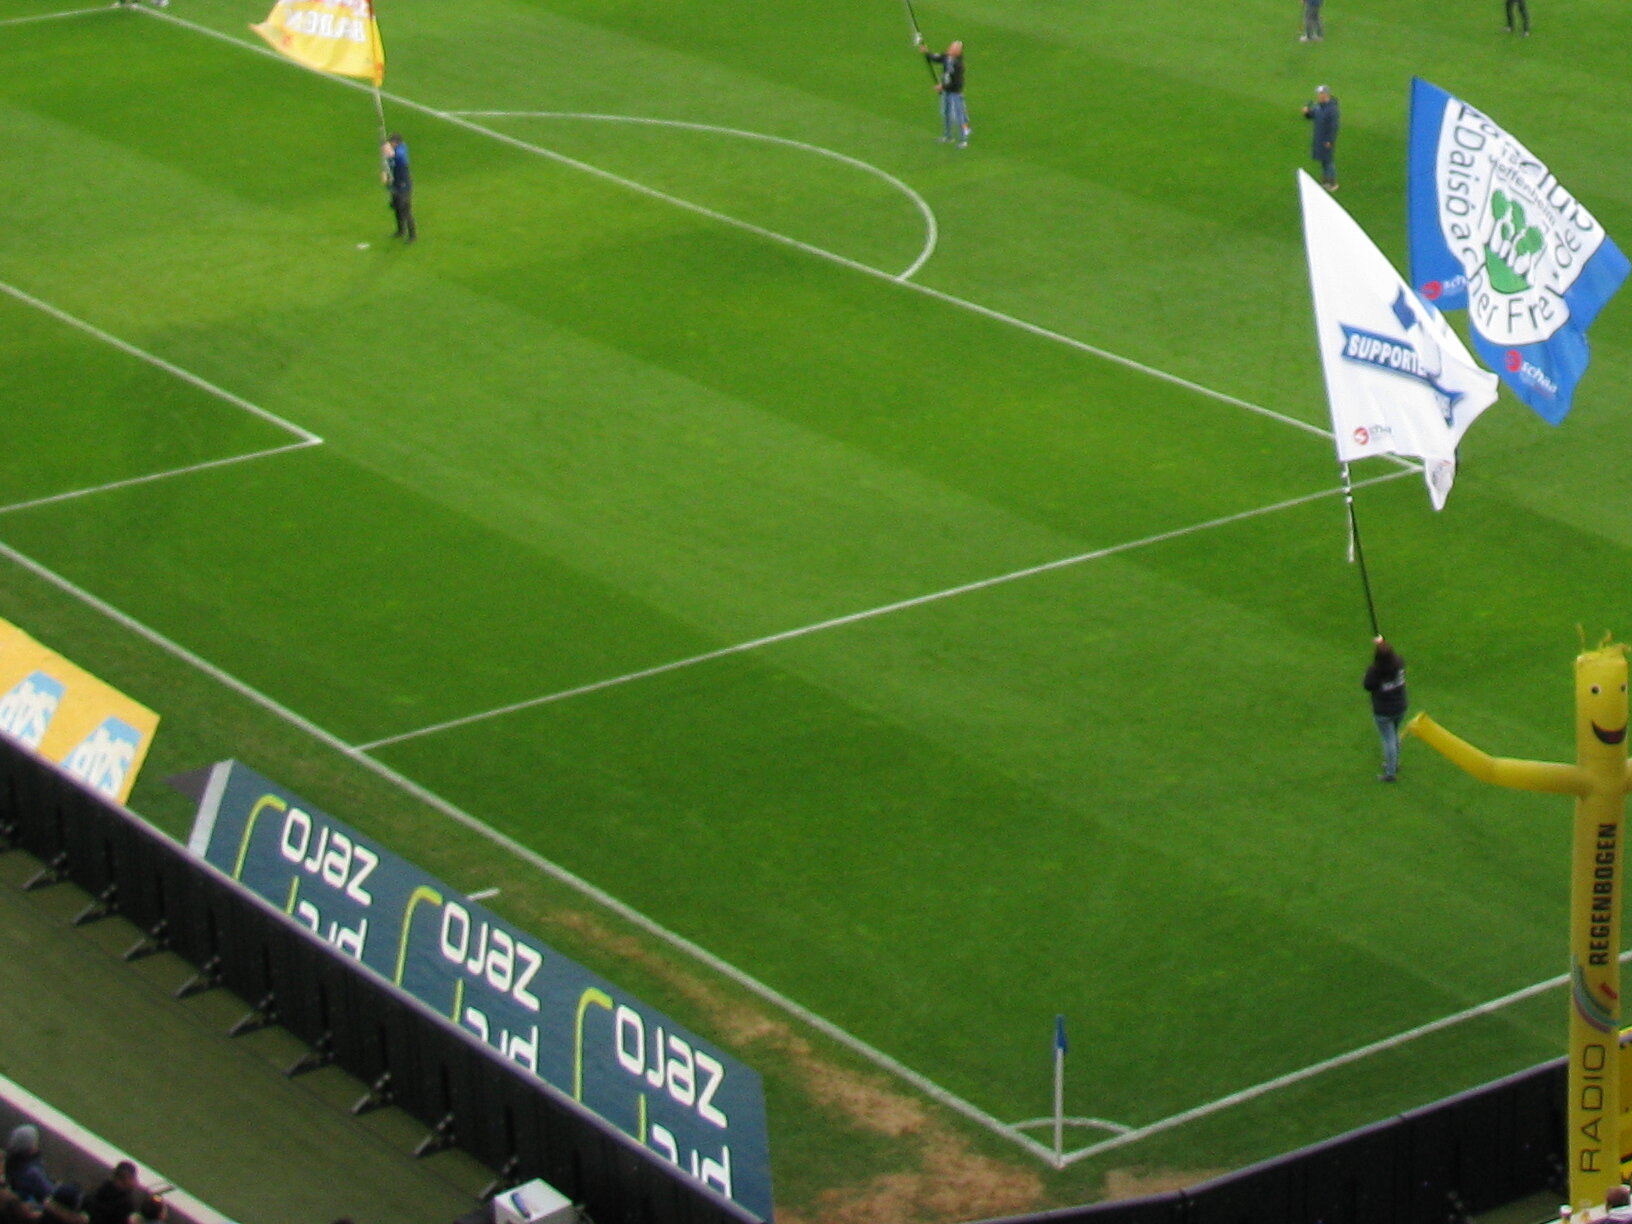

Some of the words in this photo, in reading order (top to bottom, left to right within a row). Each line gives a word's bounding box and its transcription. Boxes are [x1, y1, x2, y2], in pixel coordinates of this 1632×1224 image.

[281, 807, 379, 906] zero
[1589, 823, 1617, 967] REGENBOGEN
[440, 900, 544, 1011] zero
[615, 1004, 728, 1128] zero
[1580, 1043, 1606, 1172] RADIO
